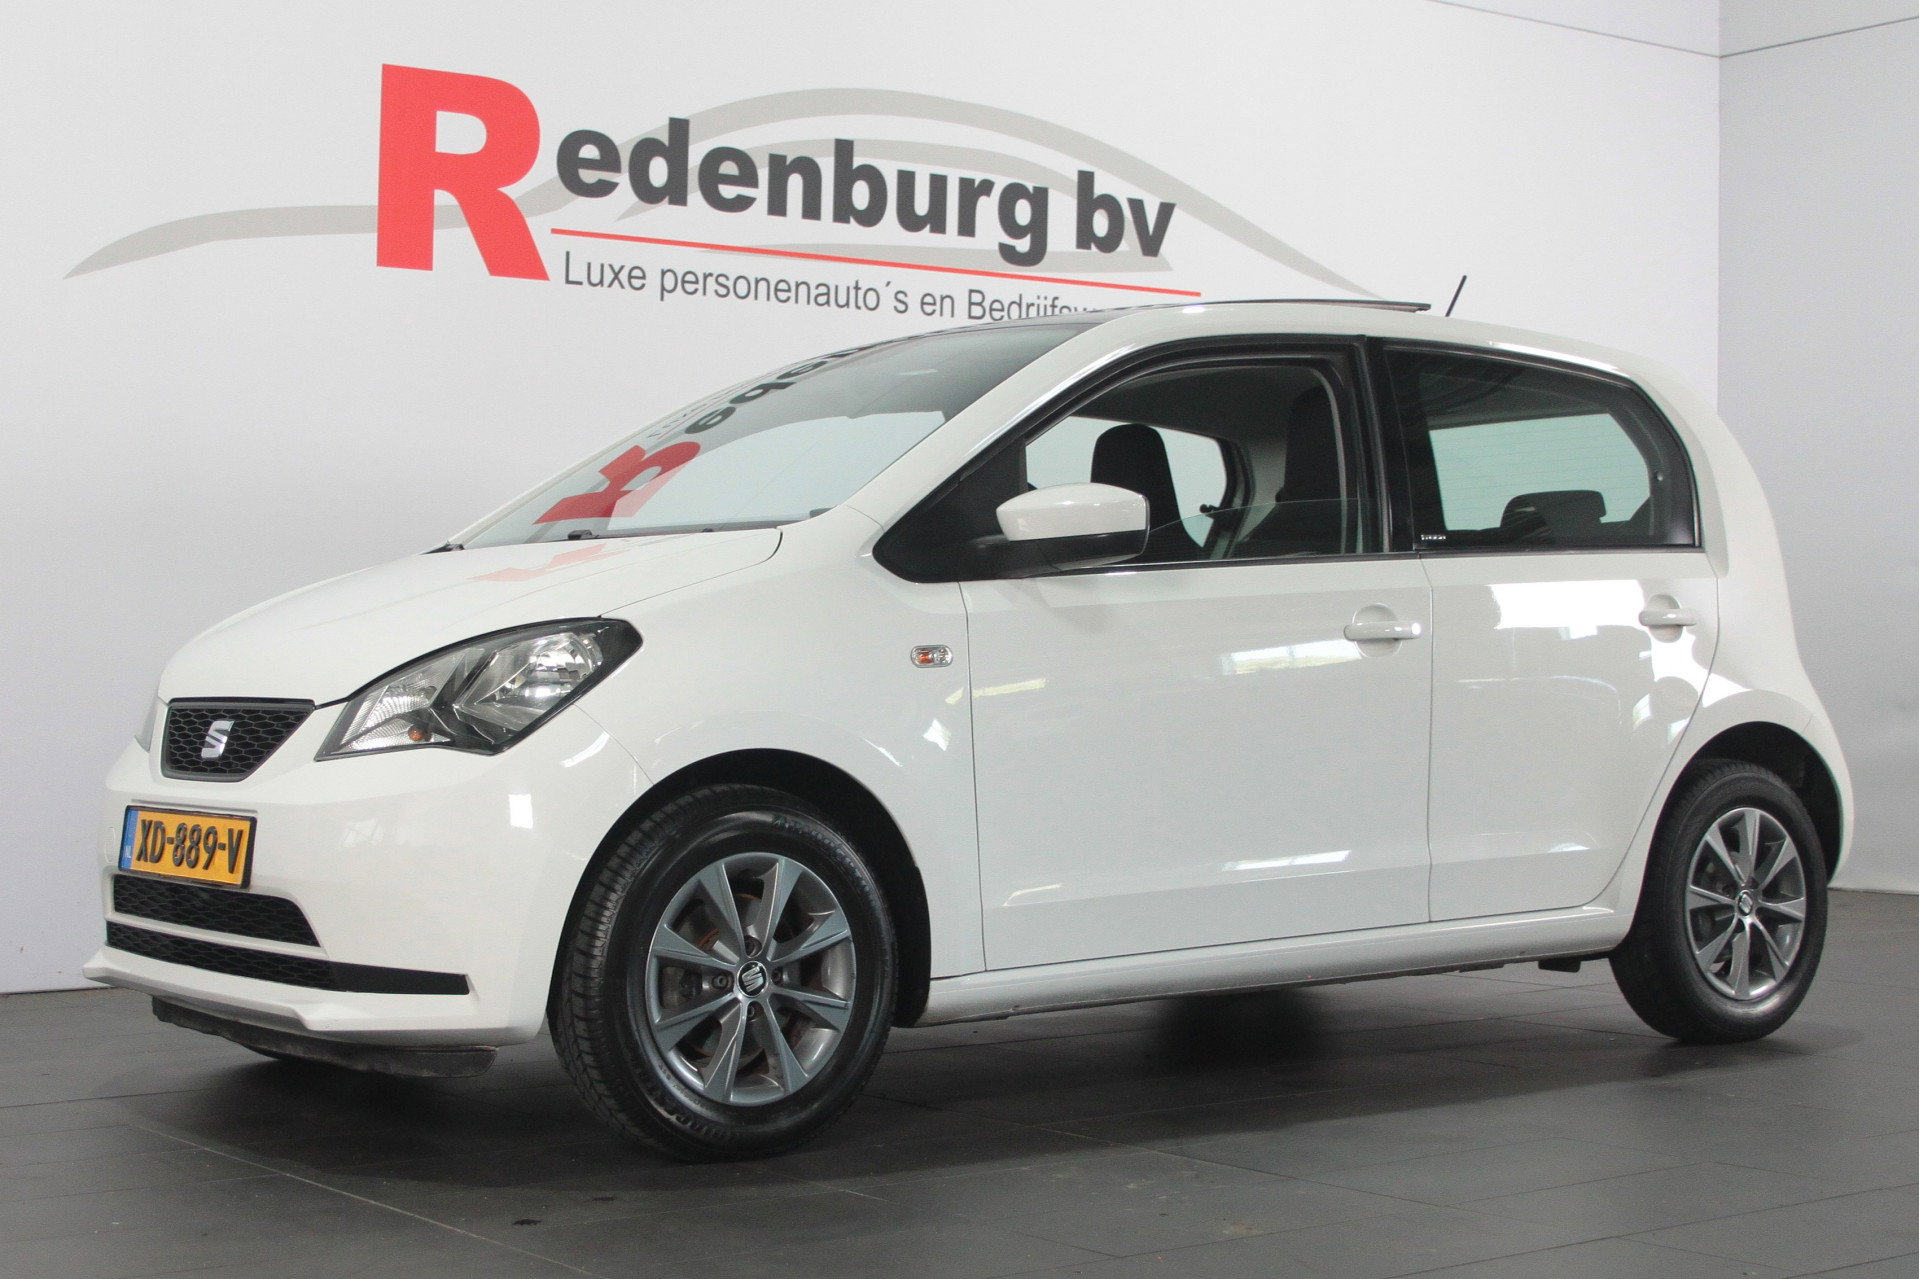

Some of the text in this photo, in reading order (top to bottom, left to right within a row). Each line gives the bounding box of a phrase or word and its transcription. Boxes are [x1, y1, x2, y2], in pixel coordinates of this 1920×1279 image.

[377, 63, 1176, 281] Redenburg bv
[565, 250, 647, 291] Luxe
[919, 292, 956, 318] en
[135, 818, 244, 875] XD-889-V
